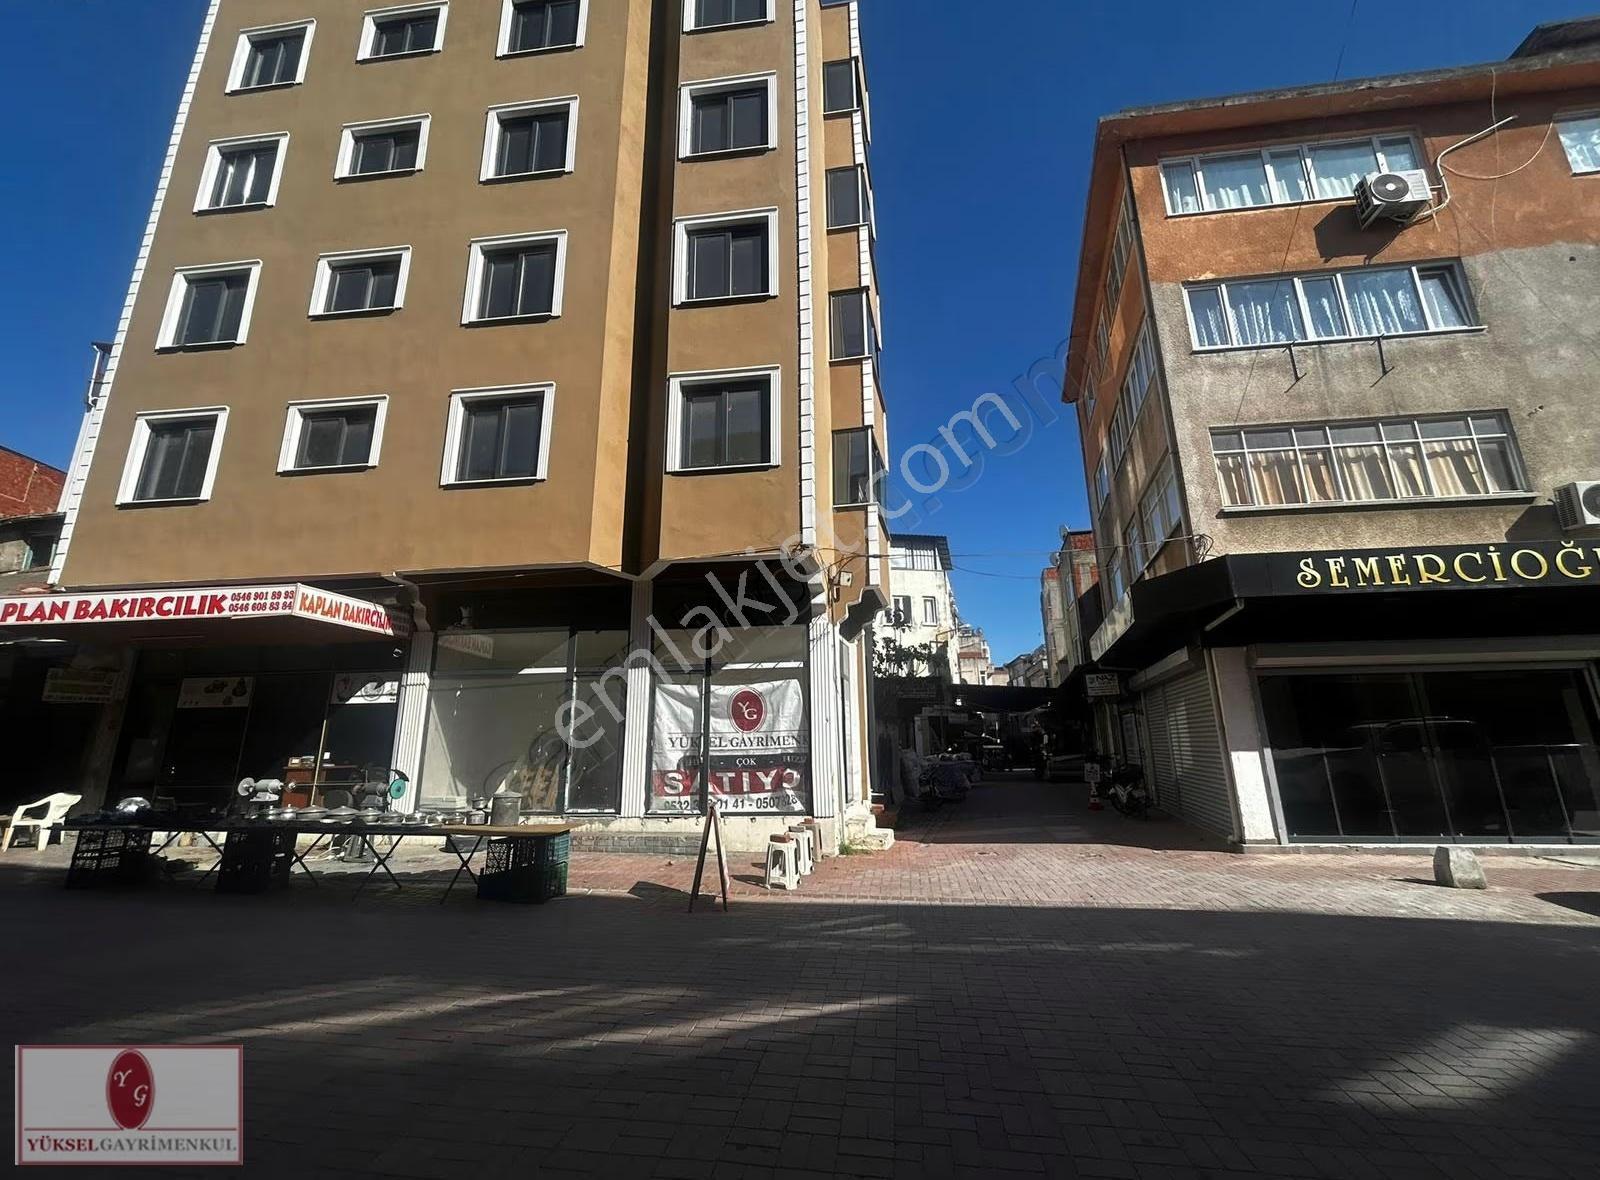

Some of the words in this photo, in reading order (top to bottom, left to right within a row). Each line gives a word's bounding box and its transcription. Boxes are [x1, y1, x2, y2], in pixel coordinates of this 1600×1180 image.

[1297, 541, 1600, 588] SEMERCİOĞ
[230, 592, 251, 602] 0546
[253, 592, 269, 602] 901
[73, 594, 229, 620] BAKIRCILIK
[228, 602, 250, 613] 0546
[251, 602, 268, 612] 608
[299, 593, 343, 619] KAPLAN
[668, 734, 728, 748] YÜKEL
[736, 758, 757, 766] ÇOK
[732, 798, 745, 809] 41
